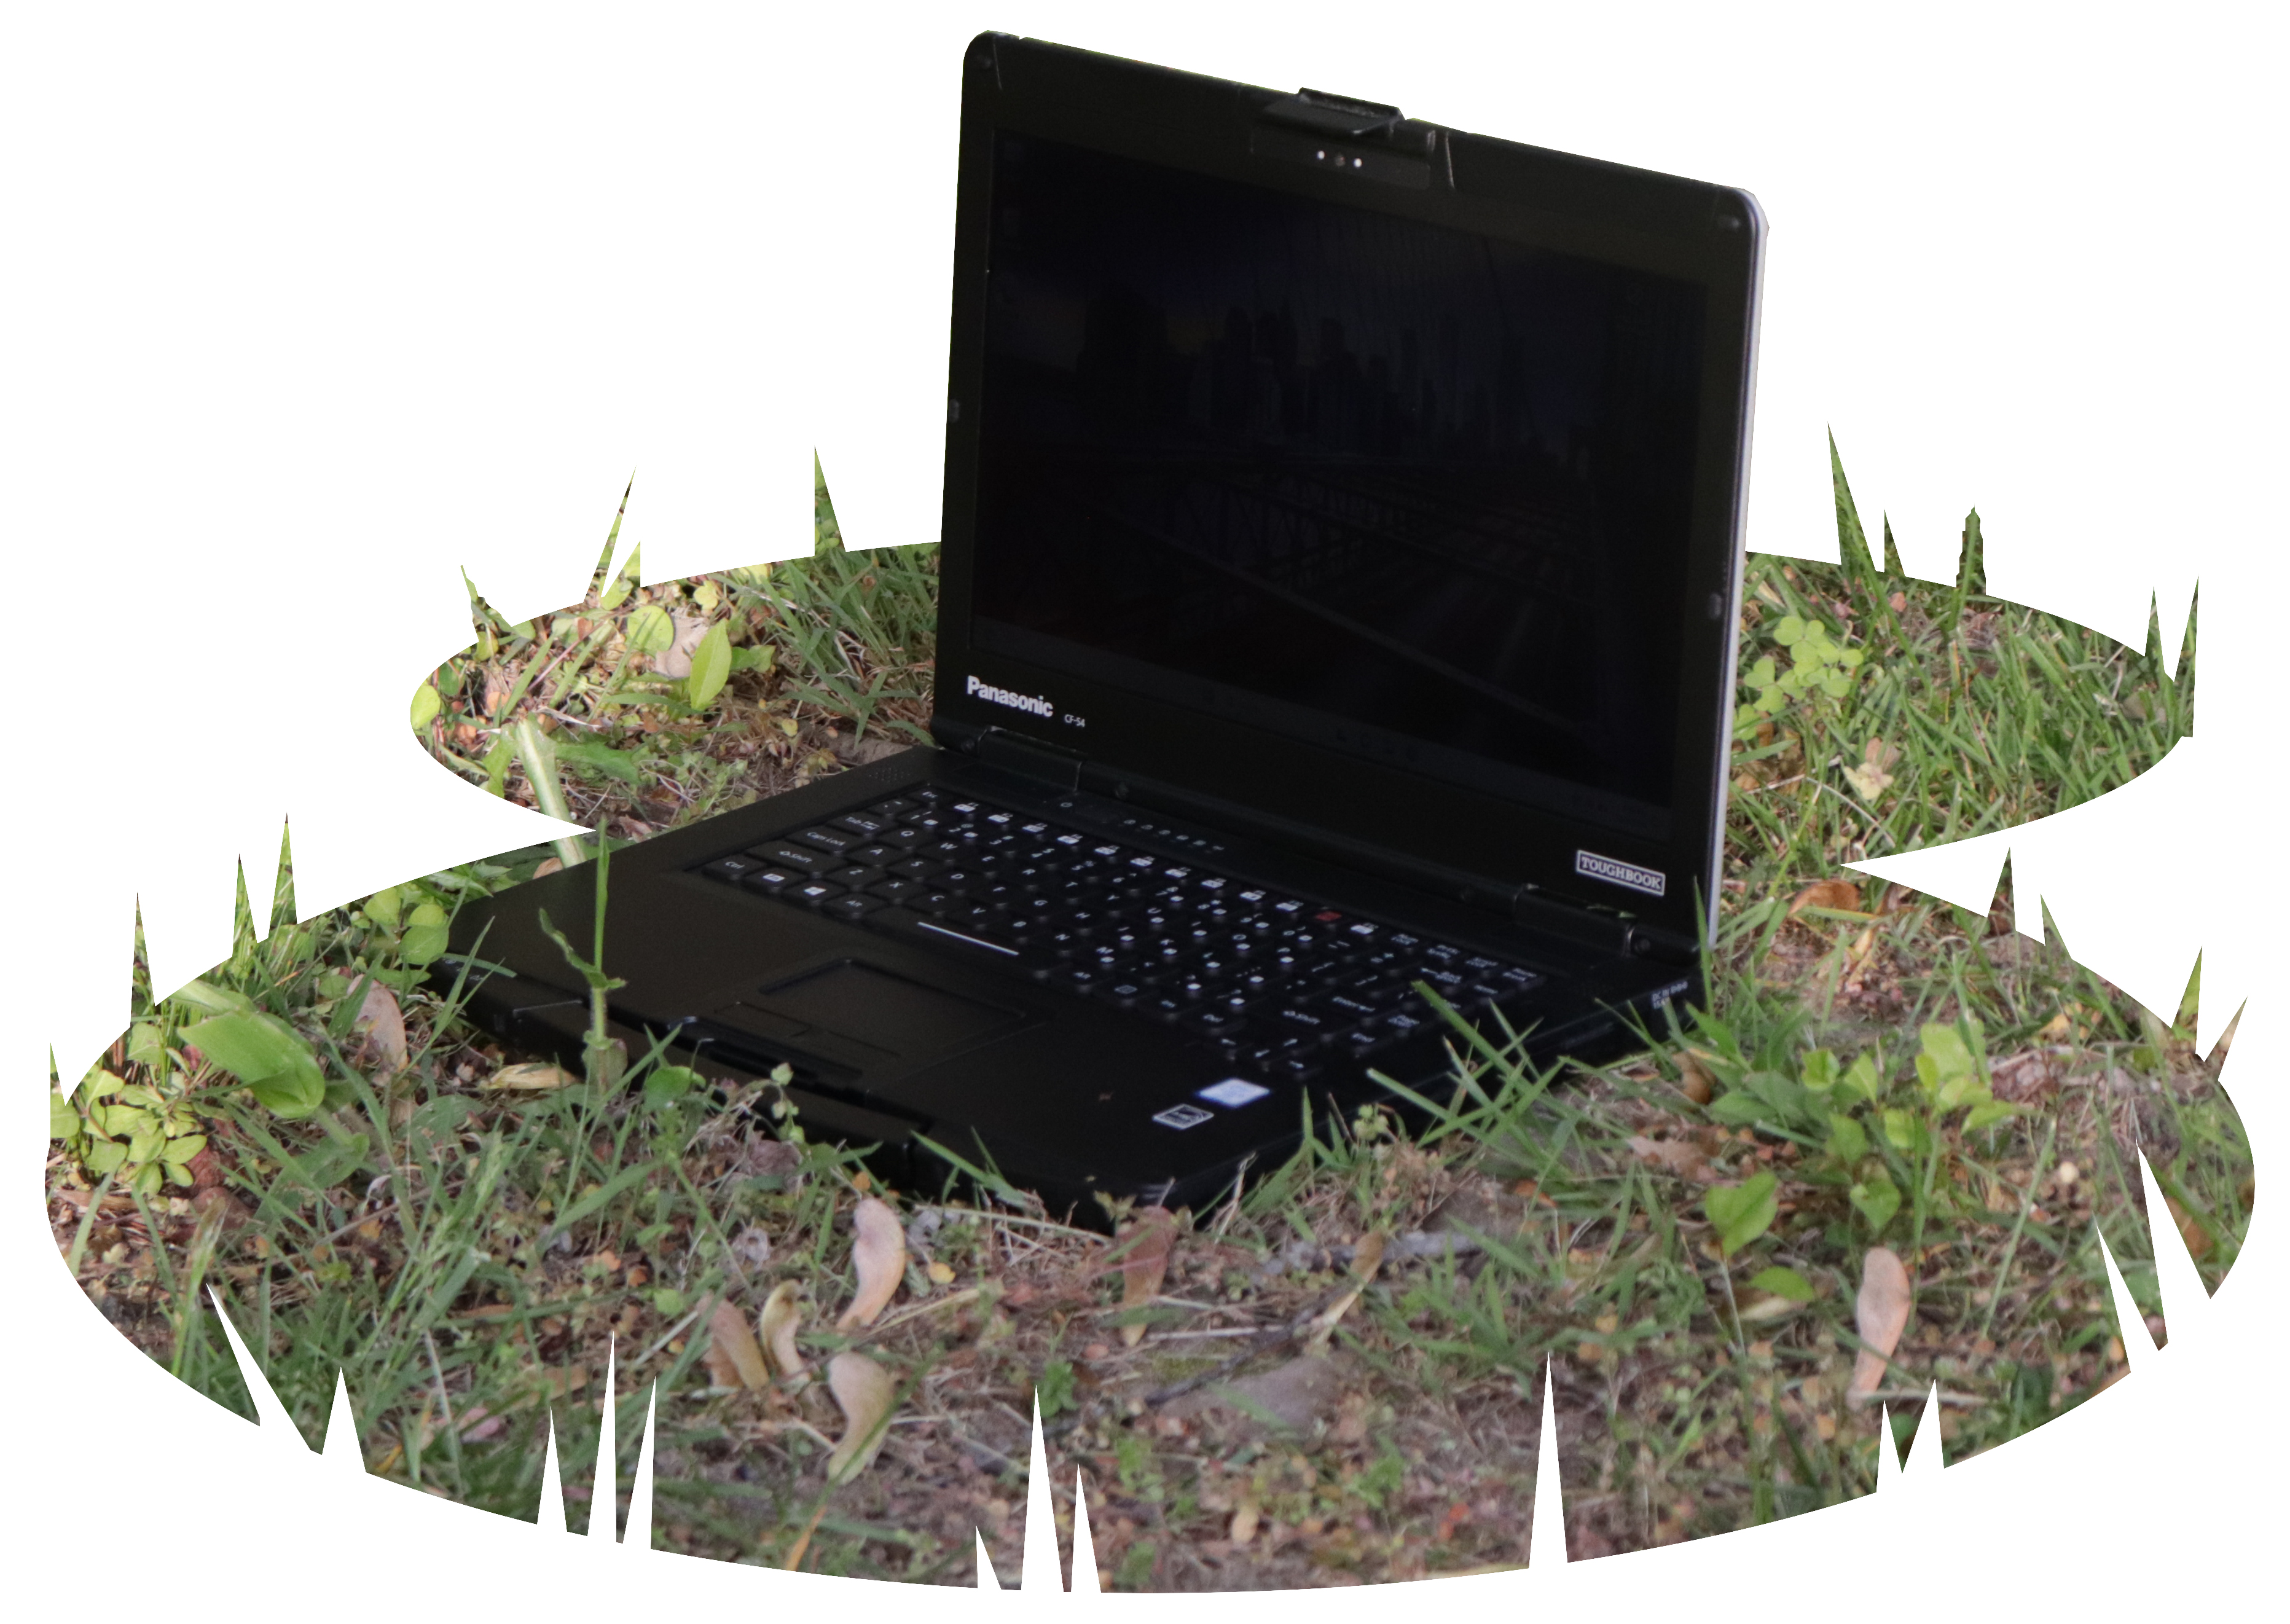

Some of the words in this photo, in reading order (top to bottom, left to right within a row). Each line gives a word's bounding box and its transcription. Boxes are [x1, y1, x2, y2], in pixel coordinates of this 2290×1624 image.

[967, 675, 1054, 718] Panasonic
[1064, 713, 1086, 728] CF-54
[939, 842, 958, 850] W
[1581, 856, 1661, 890] TOUGHBOOK
